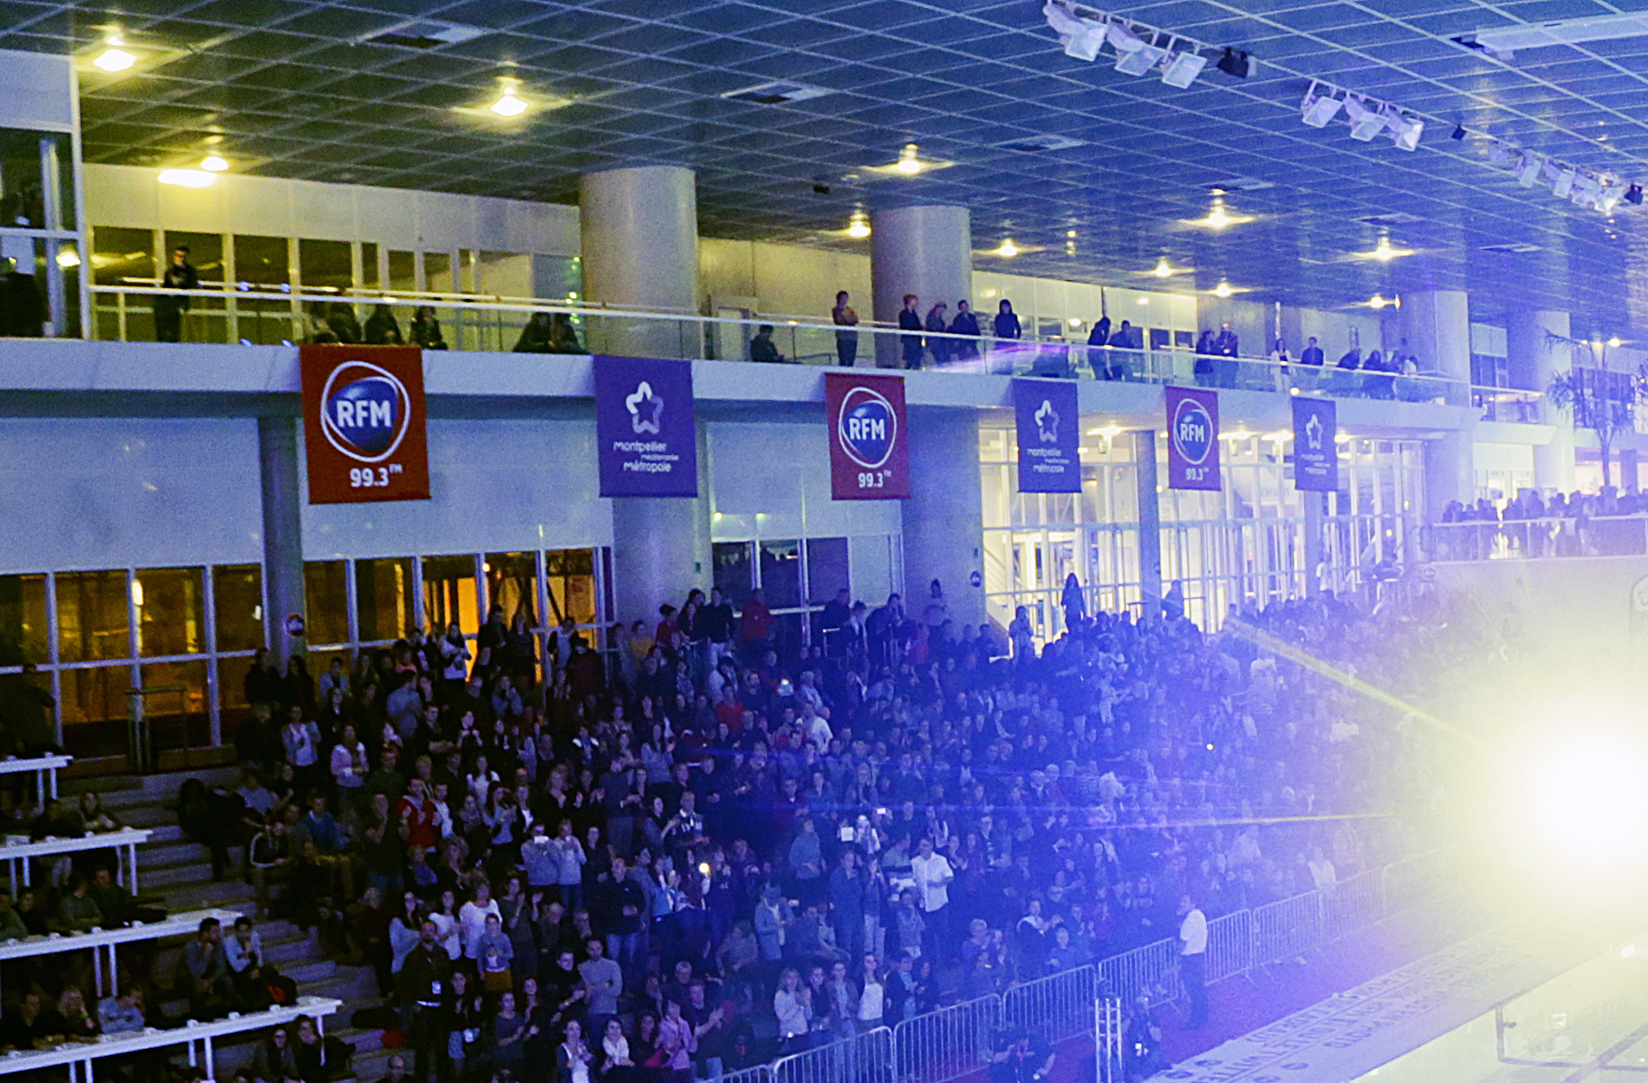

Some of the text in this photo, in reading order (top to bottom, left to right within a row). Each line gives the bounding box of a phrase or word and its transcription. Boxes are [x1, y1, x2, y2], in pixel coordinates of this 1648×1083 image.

[336, 399, 393, 428] RFM
[849, 418, 885, 440] RFM
[1180, 423, 1205, 443] RFM
[350, 467, 390, 488] 99.3
[858, 472, 884, 488] 99.3
